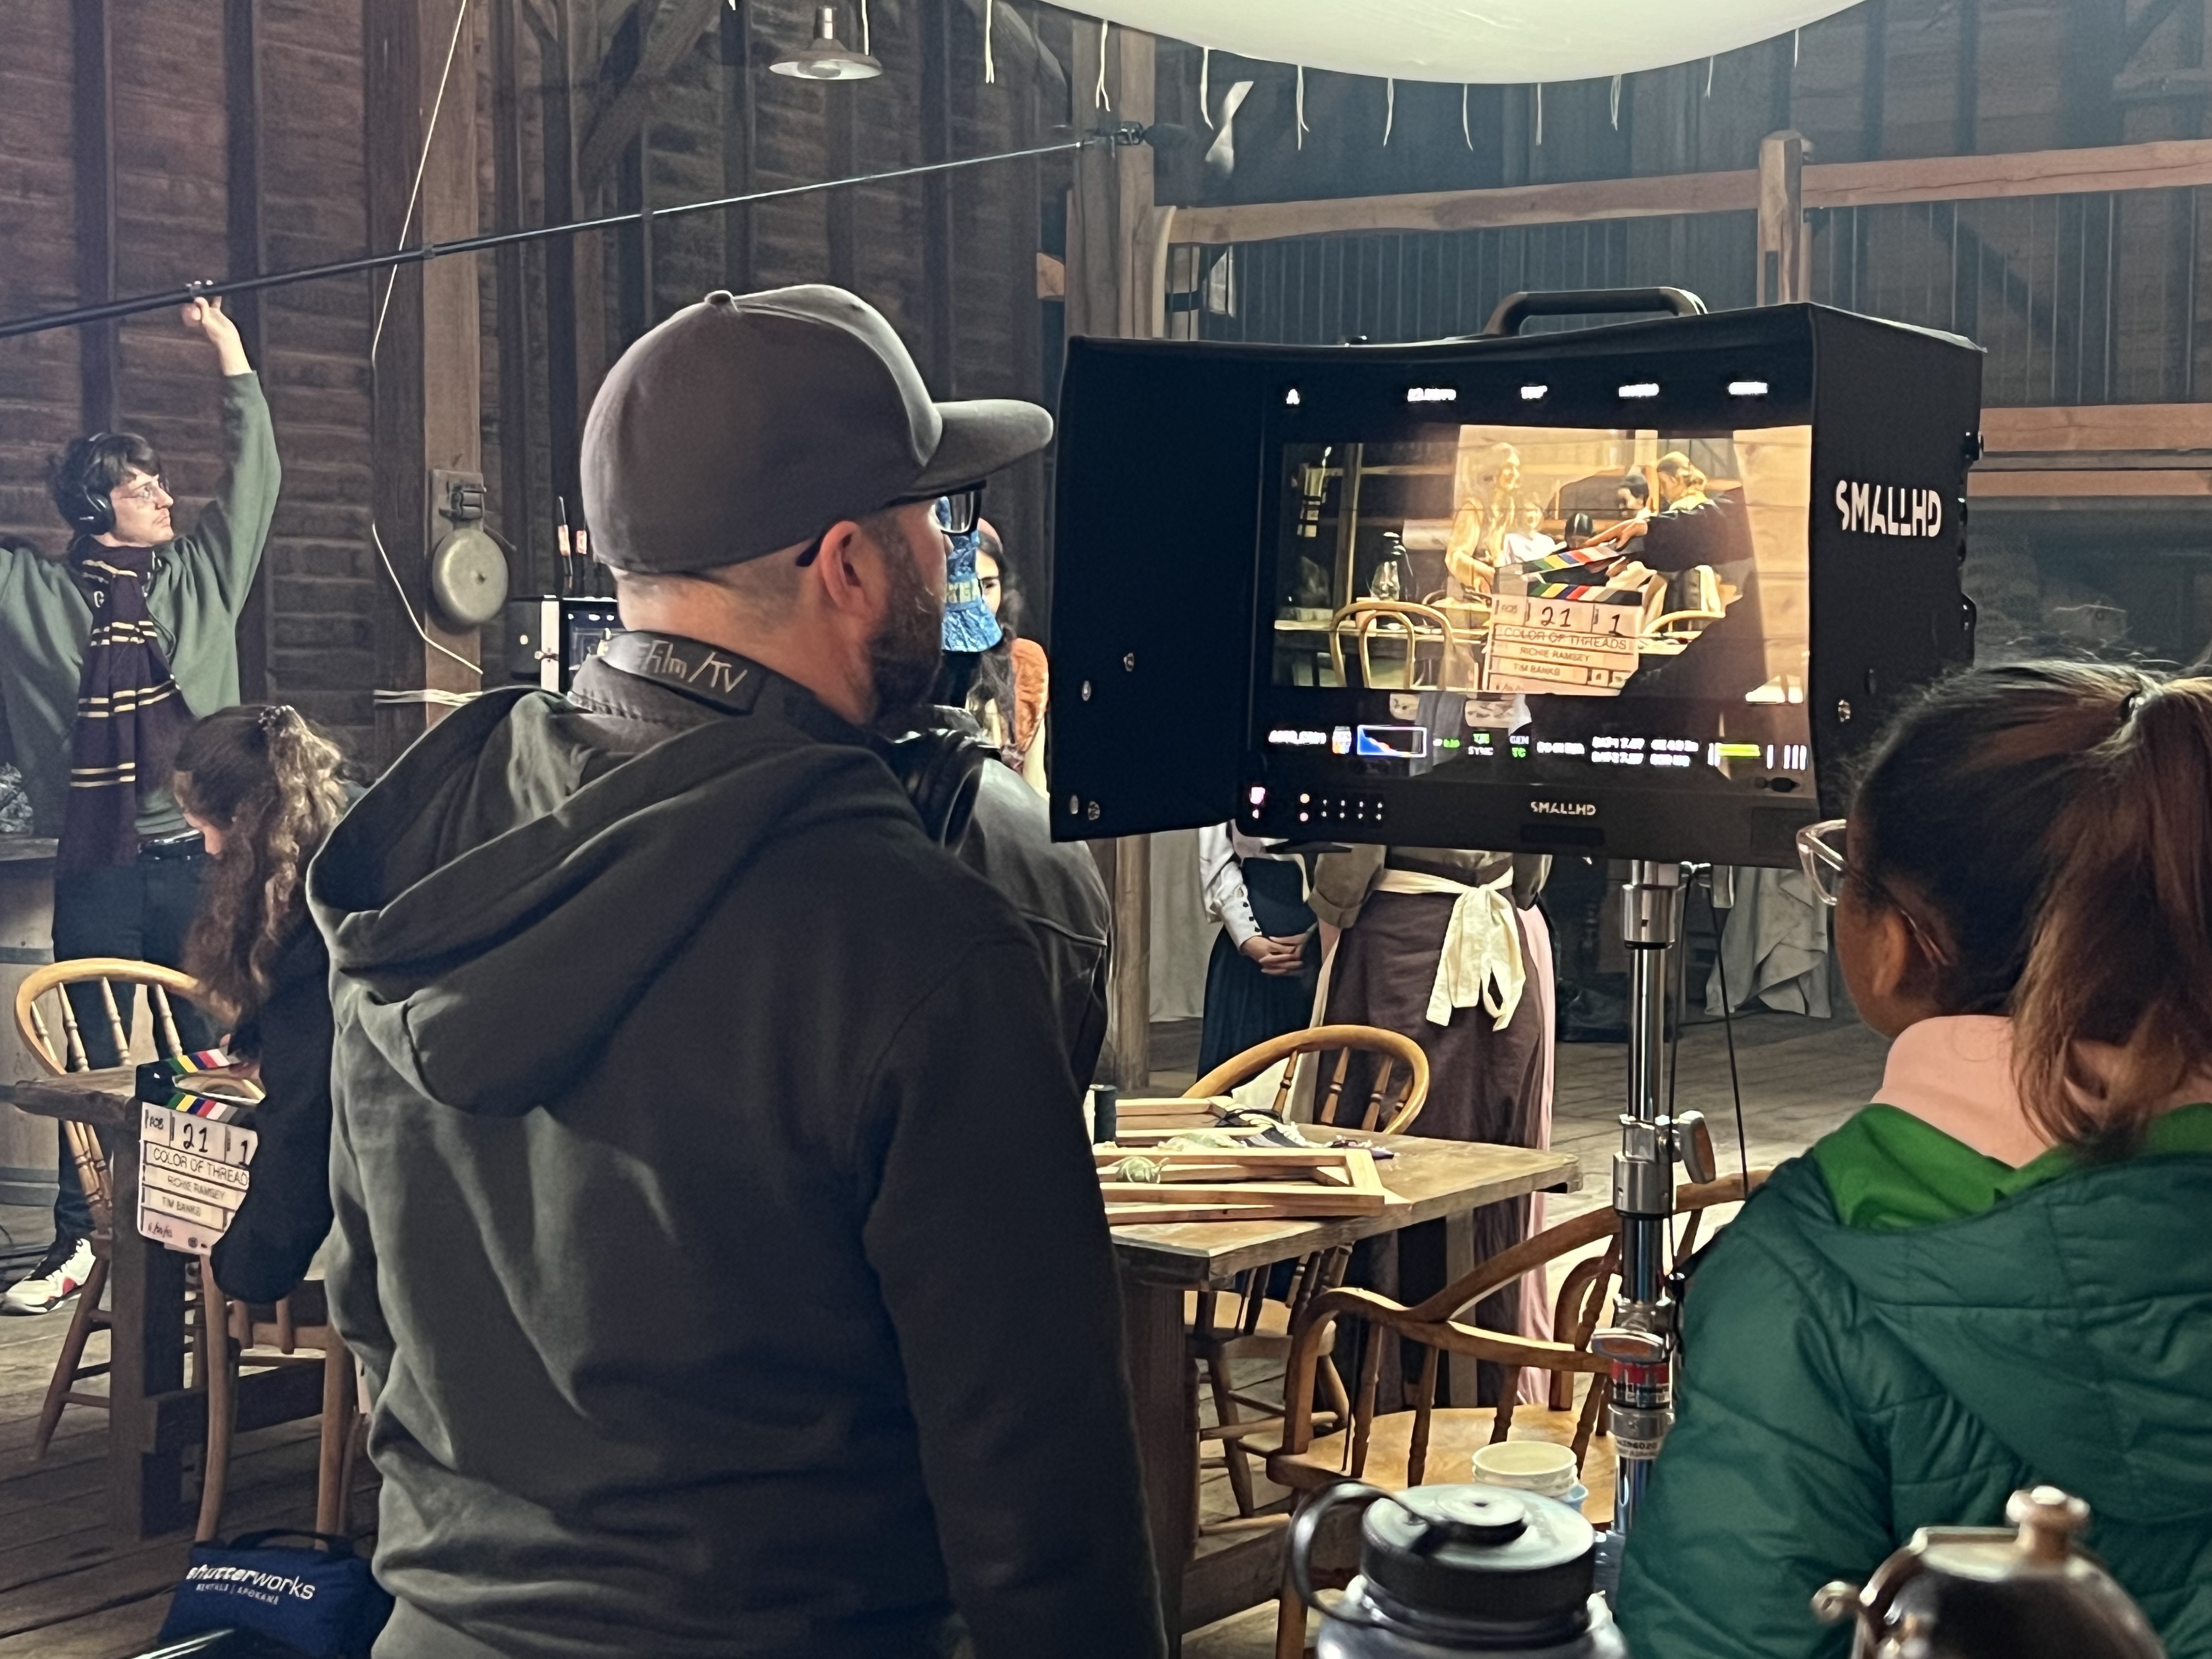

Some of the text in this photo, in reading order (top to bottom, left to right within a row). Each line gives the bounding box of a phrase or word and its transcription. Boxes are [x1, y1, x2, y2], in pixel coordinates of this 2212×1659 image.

[1836, 479, 1942, 537] SMALLHD
[1541, 606, 1571, 627] 21
[1608, 613, 1623, 636] 1
[1504, 627, 1545, 641] COLOR
[1570, 635, 1627, 650] THREADS
[1531, 801, 1596, 815] SMALLHD
[183, 1123, 208, 1153] 21
[154, 1147, 248, 1187] COLOR OF THREAD
